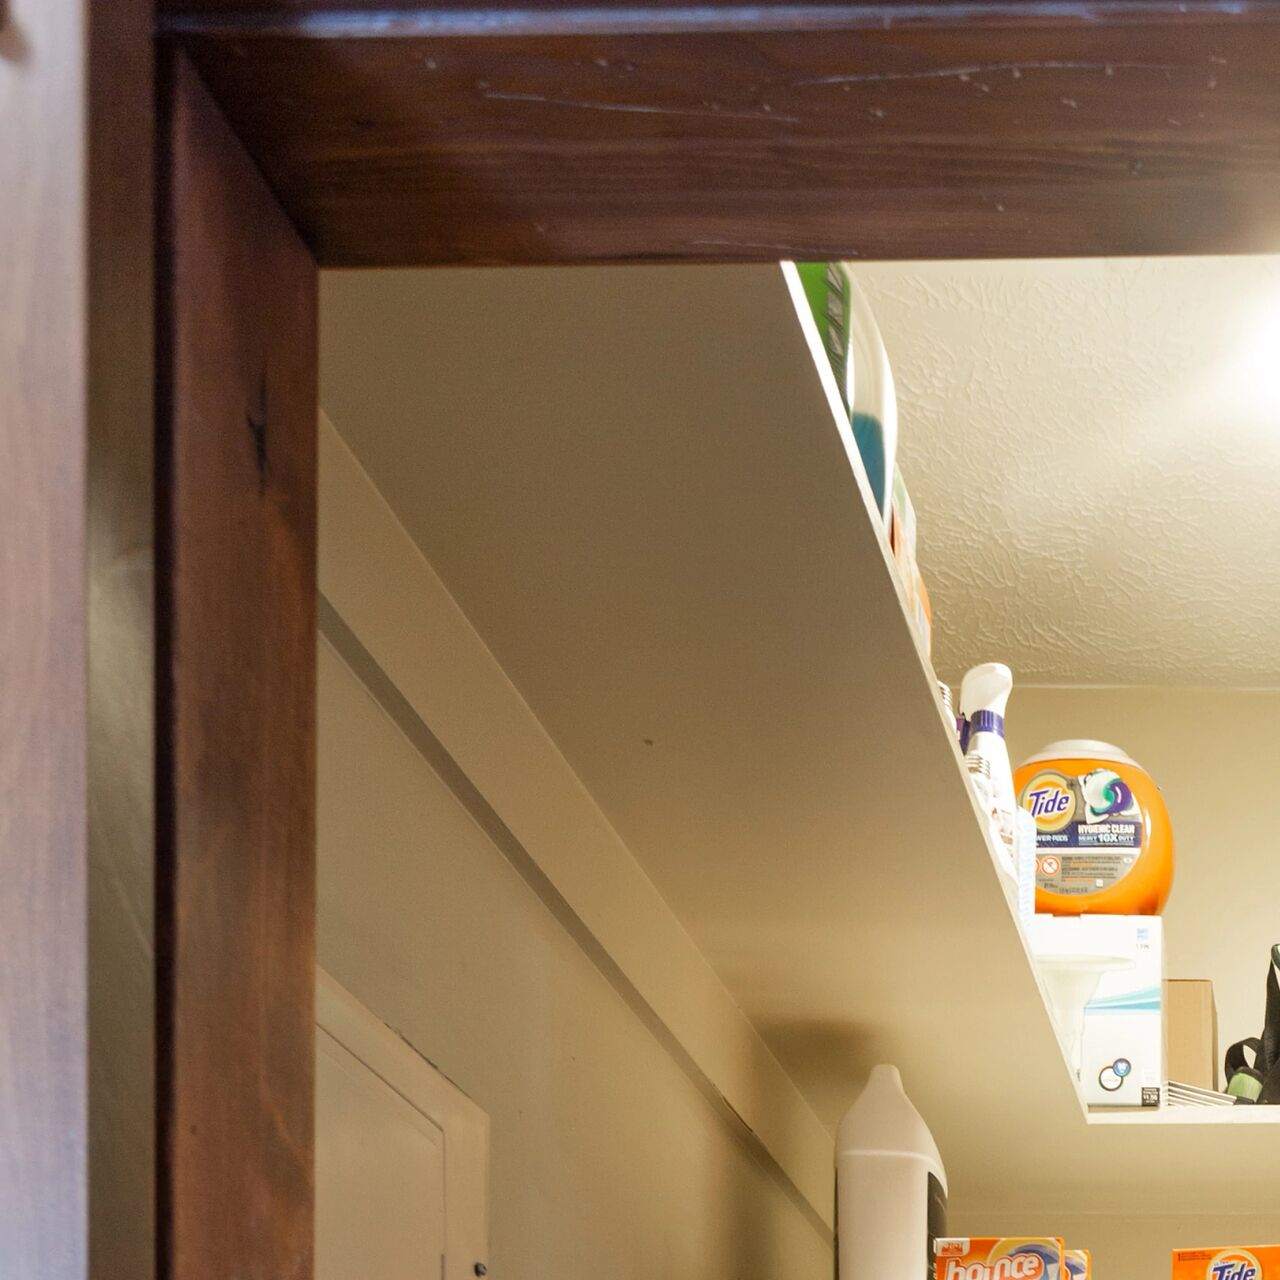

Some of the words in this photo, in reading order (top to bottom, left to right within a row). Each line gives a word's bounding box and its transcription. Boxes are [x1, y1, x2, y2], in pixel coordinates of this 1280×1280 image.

[1029, 788, 1069, 818] Tide
[1078, 824, 1111, 833] HYGIENIC
[1112, 824, 1135, 833] CLEAN
[1098, 833, 1118, 843] 10X
